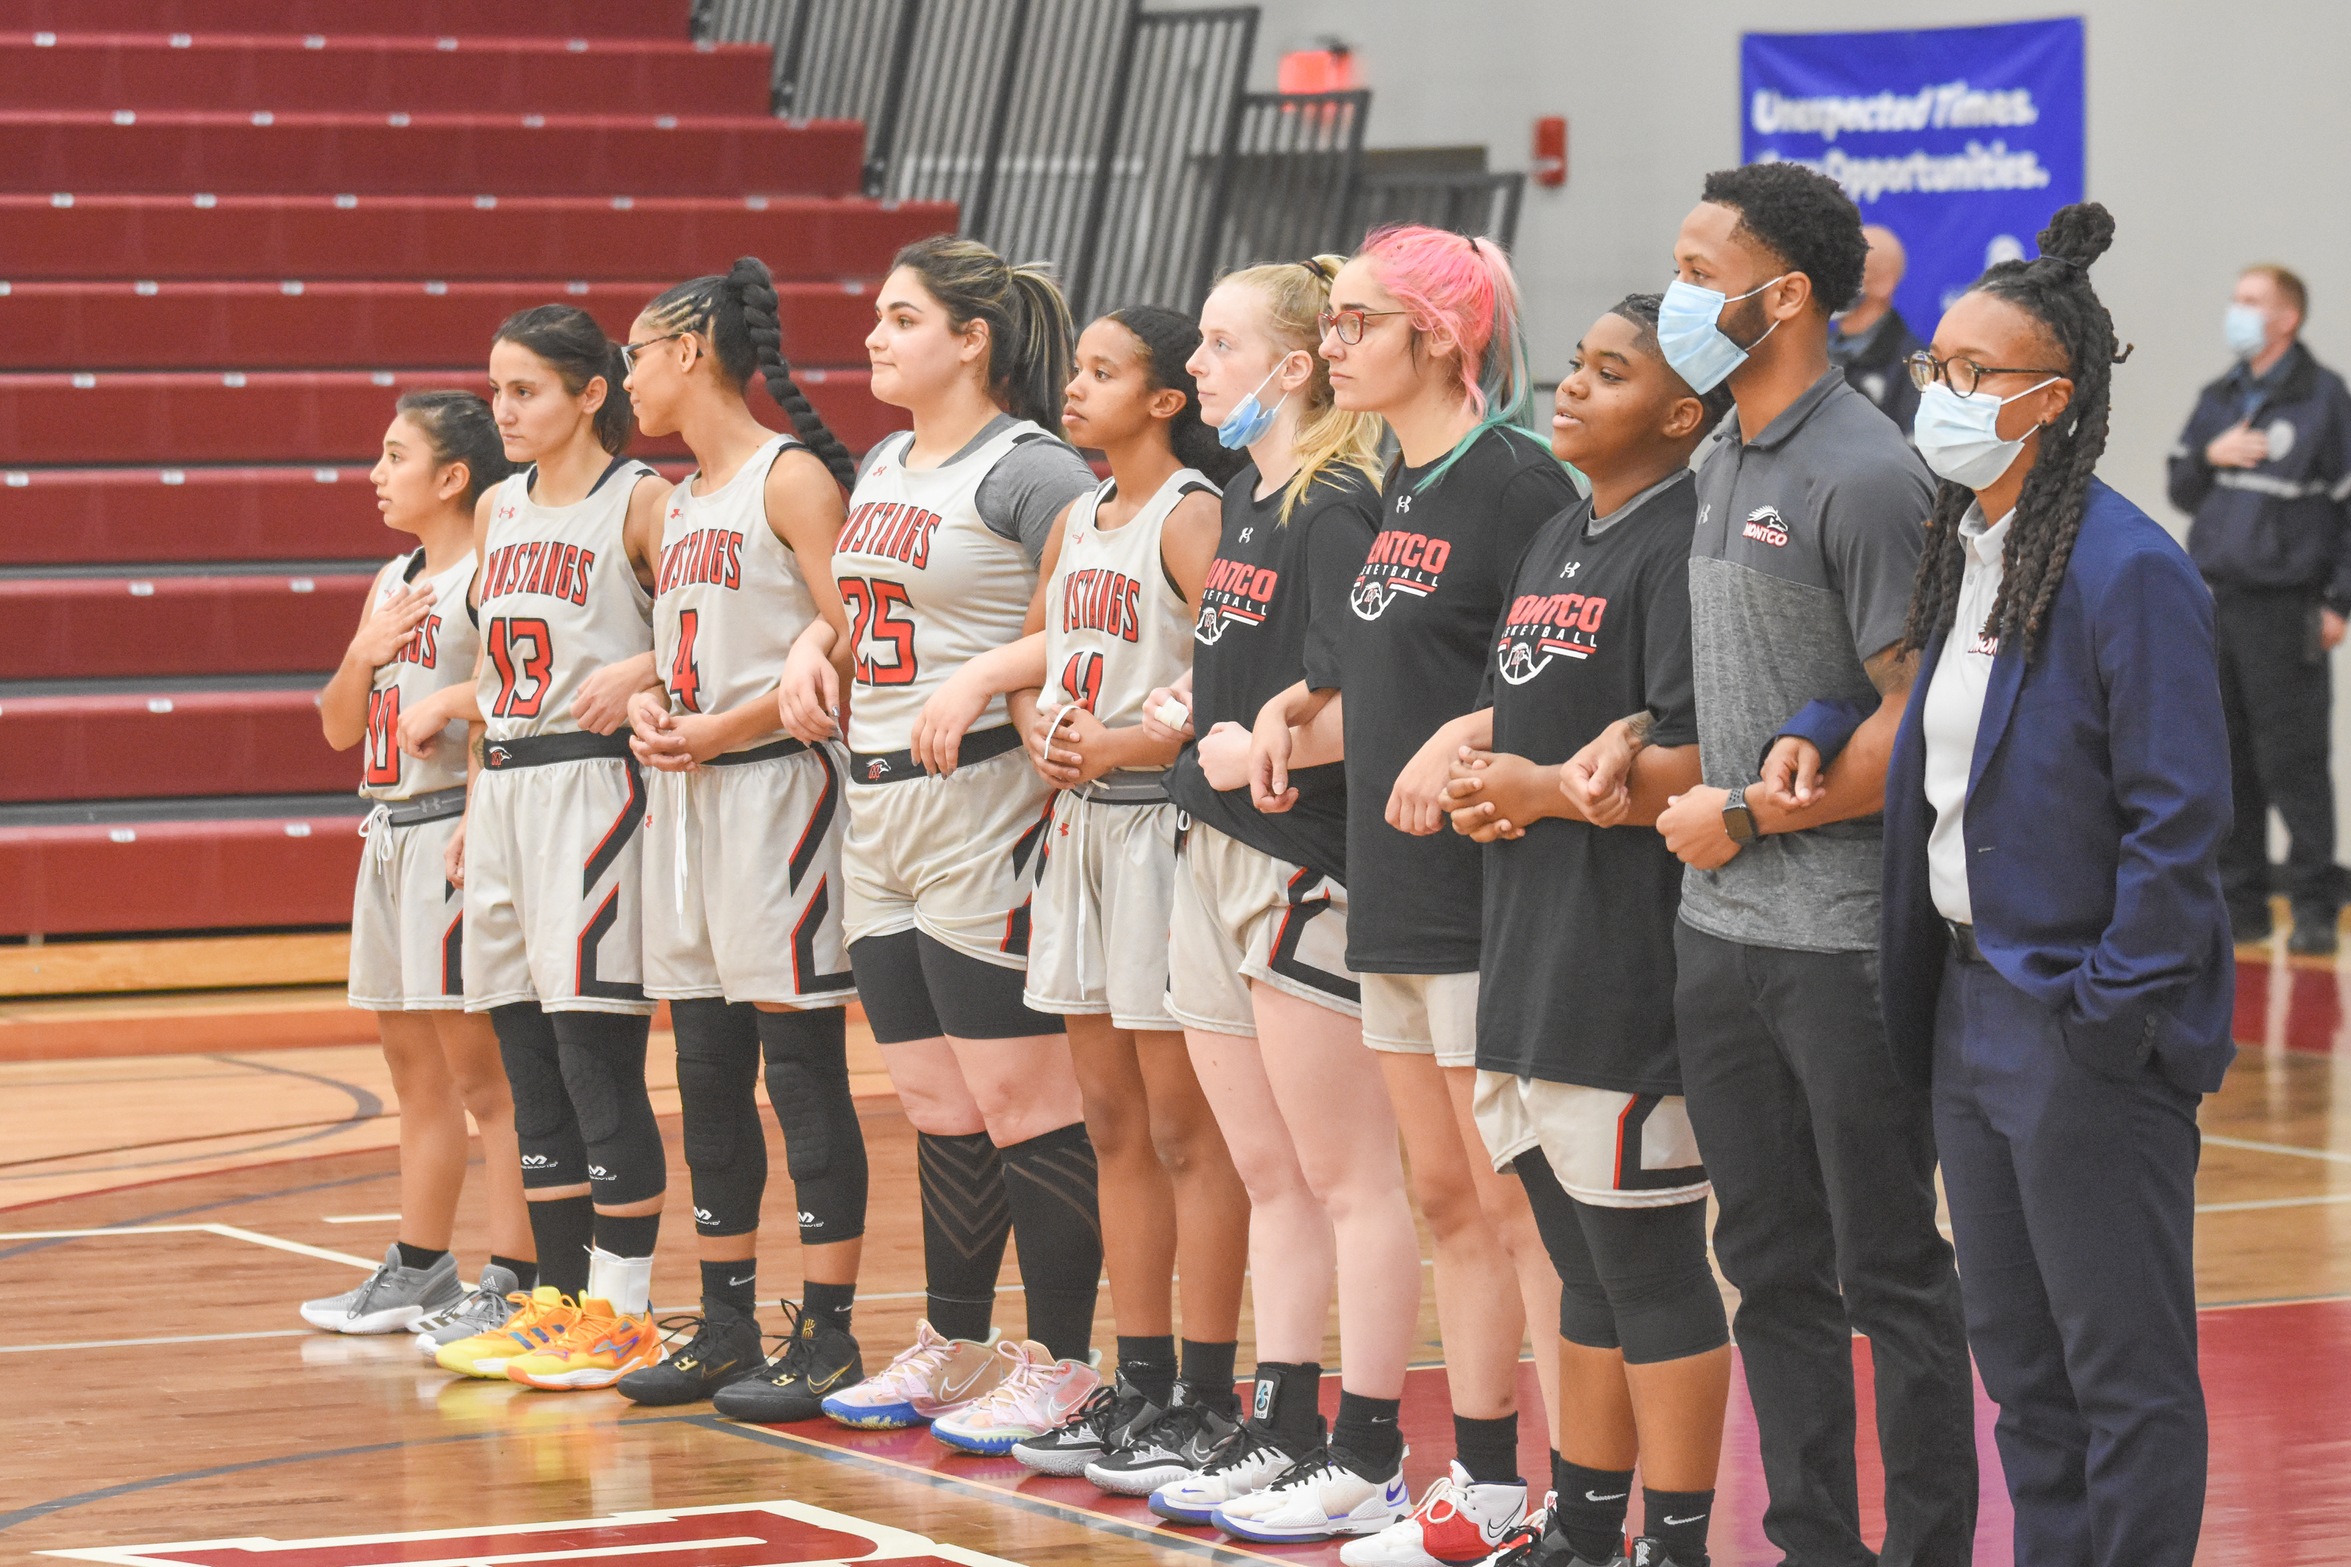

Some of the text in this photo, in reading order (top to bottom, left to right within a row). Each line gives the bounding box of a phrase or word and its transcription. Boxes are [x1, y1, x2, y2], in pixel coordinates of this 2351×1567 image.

[1752, 79, 2040, 142] Unexpected Times.
[1366, 530, 1452, 575] ONTCO
[1742, 521, 1789, 548] MONTCO
[480, 541, 596, 608] MUSTANGS
[1063, 568, 1141, 643] USTANGS
[1204, 558, 1279, 603] ONTCO
[1359, 564, 1438, 588] SKETBALL
[670, 608, 701, 713] 4
[838, 576, 919, 687] 25
[1968, 633, 1999, 656] MON
[487, 616, 554, 719] 13
